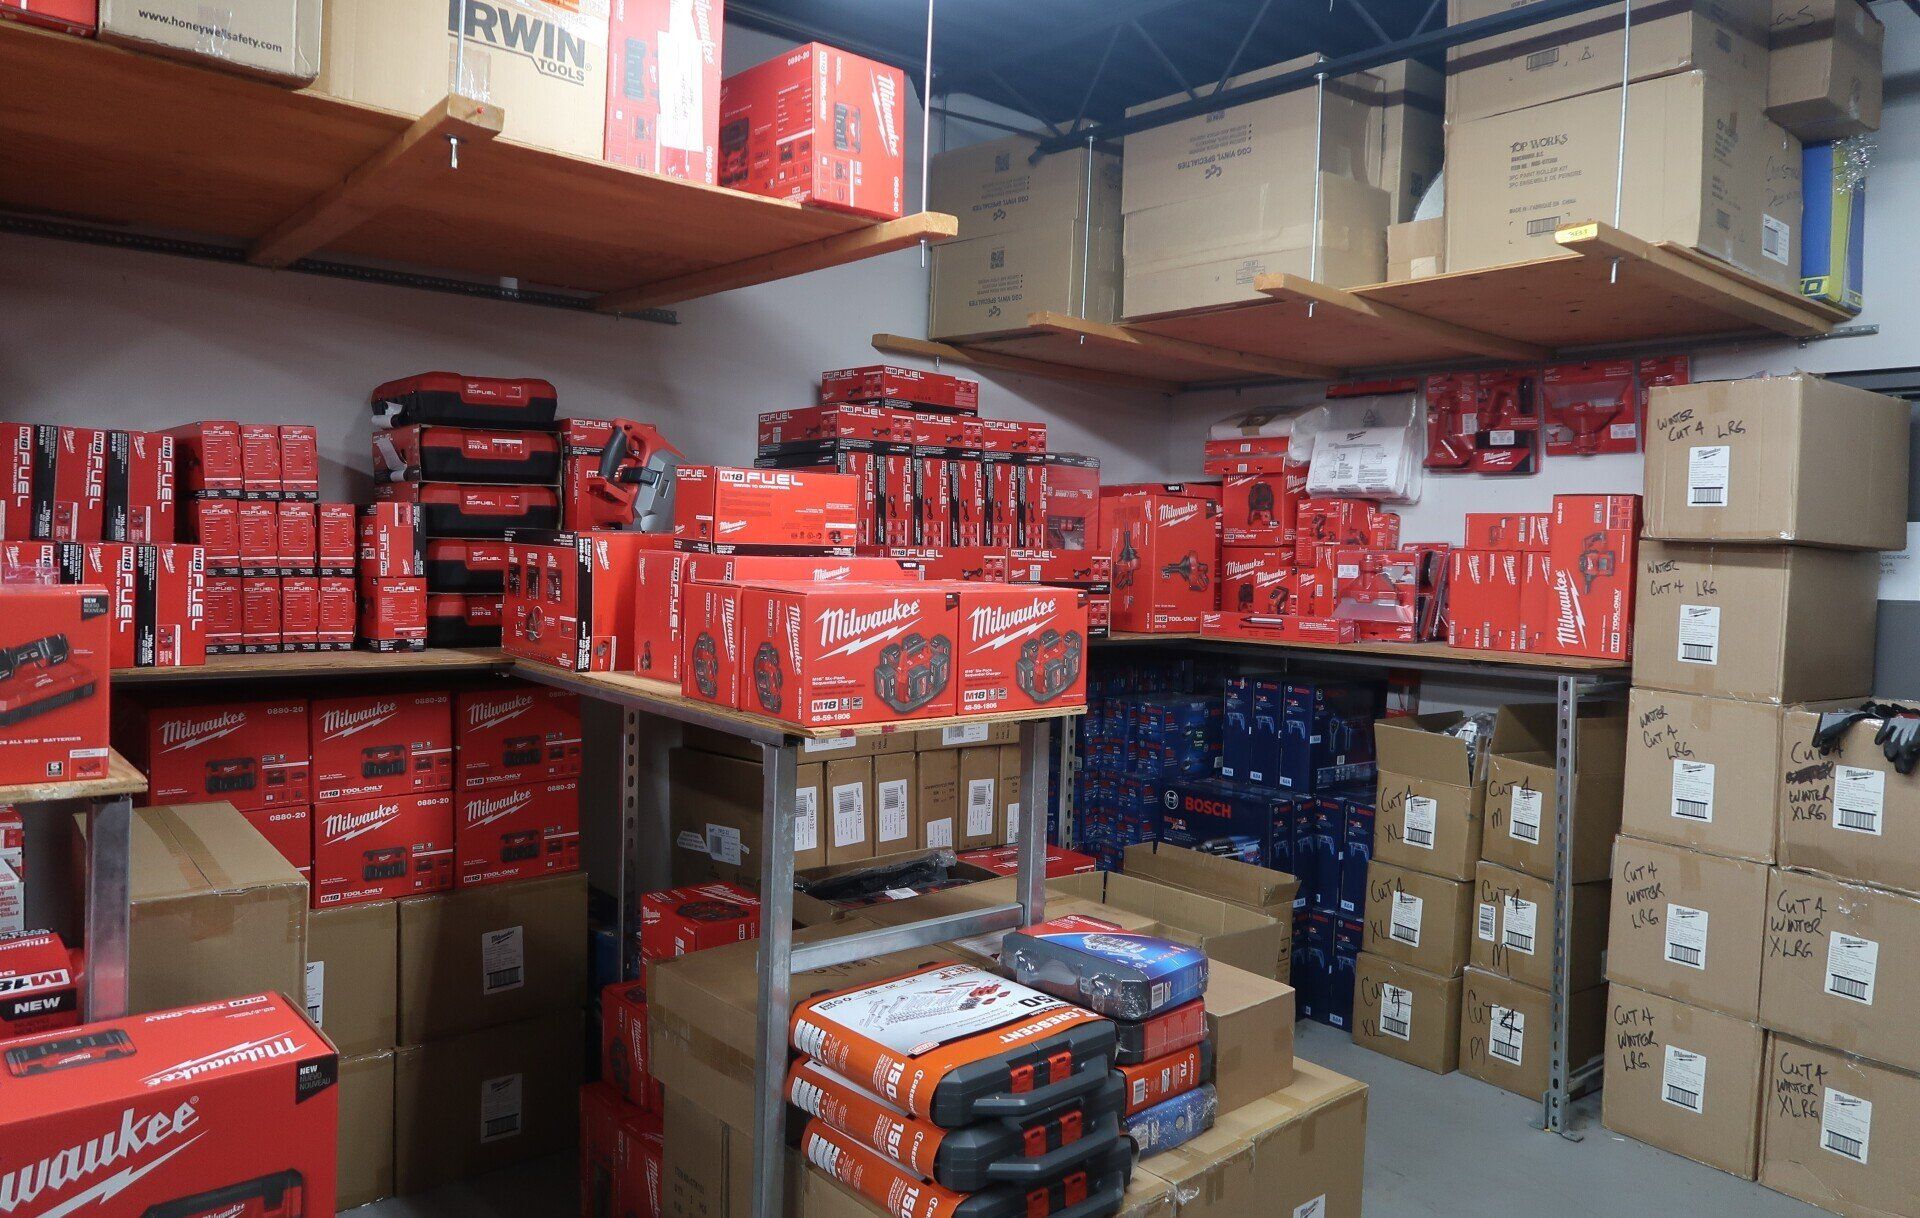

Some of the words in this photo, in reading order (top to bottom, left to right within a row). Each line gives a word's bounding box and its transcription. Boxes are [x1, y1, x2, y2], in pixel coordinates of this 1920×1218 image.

[448, 0, 586, 69] IRWIN
[537, 57, 585, 82] TOOLS
[877, 72, 899, 157] Milwaukee
[1510, 141, 1528, 153] TOP
[1530, 133, 1569, 149] WORKS
[834, 369, 859, 378] FUEL
[898, 369, 925, 379] FUEL
[770, 412, 793, 421] FUEL
[854, 407, 885, 417] FUEL
[929, 414, 957, 424] FUEL
[1657, 408, 1694, 431] WINTER
[996, 421, 1022, 430] FUEL
[1694, 421, 1705, 437] 4
[1717, 420, 1746, 438] LRG
[19, 426, 31, 450] M18
[92, 431, 105, 455] M18
[162, 436, 173, 459] M18
[17, 451, 30, 507] FUEL
[89, 455, 103, 510] FUEL
[161, 460, 173, 513] FUEL
[720, 470, 745, 482] M18
[747, 472, 803, 486] FUEL
[1158, 502, 1198, 521] Milwaukee
[122, 546, 134, 571] M18
[192, 547, 205, 571] M18
[890, 548, 906, 556] M18
[906, 549, 943, 558] FUEL
[1011, 549, 1025, 557] M18
[1025, 550, 1056, 559] FUEL
[813, 565, 850, 580] Milwaukee
[1226, 559, 1265, 576] Milwaukee
[1256, 569, 1287, 583] Milwaukee
[1673, 580, 1685, 594] 4
[1696, 580, 1718, 597] LRG
[120, 572, 134, 633] FUEL
[192, 573, 204, 631] FUEL
[1554, 570, 1579, 649] Milwaukee
[1612, 589, 1620, 631] TOOL-ONLY
[671, 583, 679, 642] FUEL
[966, 597, 1057, 642] Milwaukee
[813, 599, 920, 647] Milwaukee
[414, 696, 448, 705] 0880-20
[964, 689, 987, 701] M18
[267, 706, 304, 715] 0880-20
[467, 694, 534, 724] Milwaukee
[812, 699, 838, 712] M18
[963, 702, 998, 711] 48-59-1806
[318, 701, 398, 734] Milwaukee
[811, 713, 851, 722] 48-59-1806
[1639, 705, 1668, 729] WINTER
[158, 711, 247, 745] Milwaukee
[1665, 724, 1679, 739] 4
[1667, 742, 1695, 760] LRG
[466, 777, 484, 787] M18
[485, 773, 522, 783] TOOL-ONLY
[547, 782, 576, 793] 0880-20
[1520, 776, 1535, 800] 4
[318, 788, 340, 799] M18
[342, 784, 383, 795] TOOL-ONLY
[416, 796, 450, 807] 0880-20
[1404, 785, 1419, 811] 4
[1789, 785, 1834, 804] WINTER
[464, 789, 533, 821] Milwaukee
[1184, 796, 1232, 819] BOSCH
[1791, 804, 1827, 822] XLRG
[269, 811, 306, 822] 0880-20
[321, 804, 401, 837] Milwaukee
[1492, 808, 1503, 829] M
[1384, 824, 1405, 843] XL
[463, 873, 482, 883] M18
[482, 868, 519, 879] TOOL-ONLY
[1647, 860, 1658, 876] 4
[320, 893, 341, 904] M18
[342, 887, 384, 899] TOOL-ONLY
[1510, 887, 1526, 915] 4
[1626, 882, 1666, 905] WINTER
[1813, 896, 1828, 918] 4
[1632, 908, 1660, 929] LRG
[1770, 916, 1825, 937] WINTER
[1370, 920, 1391, 943] XL
[1769, 935, 1814, 959] XLRG
[1492, 944, 1509, 977] M
[14, 996, 62, 1014] NEW
[1391, 987, 1412, 1017] 4
[144, 1005, 227, 1024] TOOL-ONLY
[1639, 1006, 1655, 1027] 4
[1000, 1010, 1078, 1045] CRESCENT
[1362, 1019, 1383, 1037] XL
[1500, 1009, 1523, 1045] 4
[1617, 1031, 1659, 1050] WINTER
[145, 1037, 308, 1087] Milwaukee
[300, 1064, 318, 1075] NEW
[1180, 1060, 1187, 1077] 70
[1623, 1052, 1650, 1071] LRG
[300, 1072, 322, 1082] NUEVO
[886, 1062, 905, 1100] 150
[1812, 1062, 1829, 1082] 4
[300, 1077, 330, 1090] NOUVEAU
[1778, 1094, 1820, 1121] XLRG
[888, 1123, 905, 1161] 150
